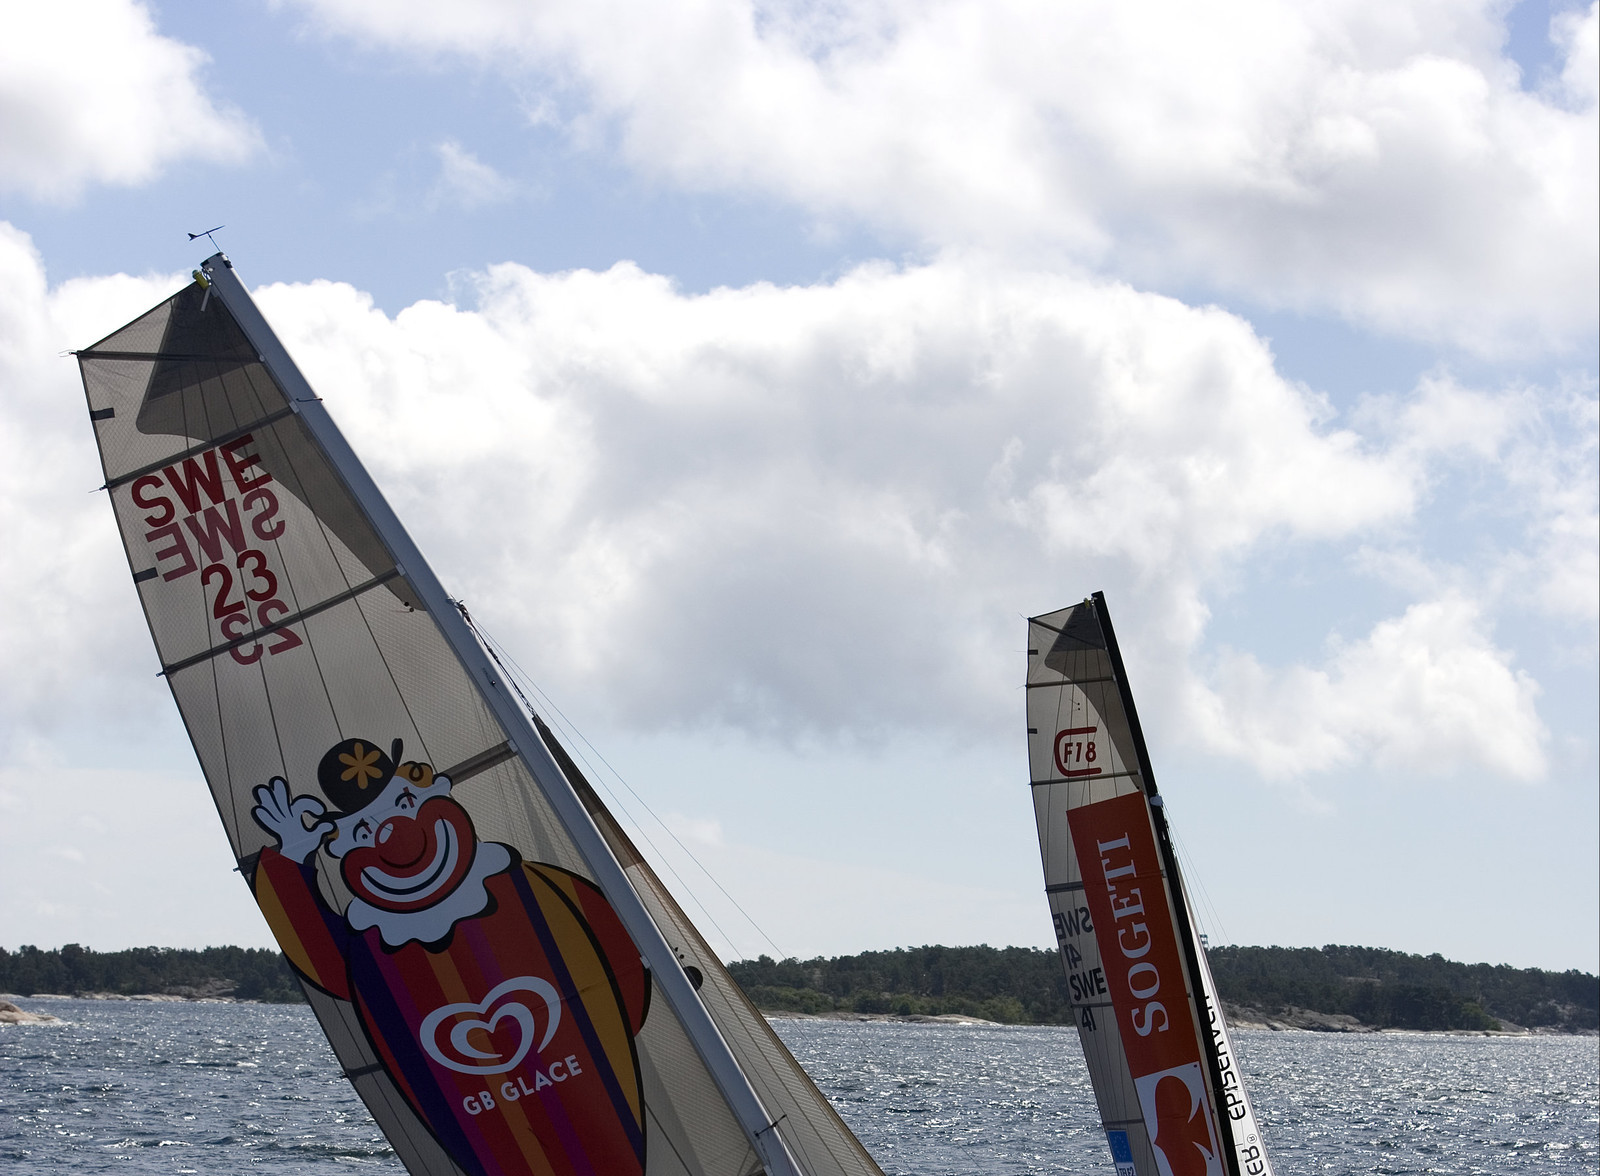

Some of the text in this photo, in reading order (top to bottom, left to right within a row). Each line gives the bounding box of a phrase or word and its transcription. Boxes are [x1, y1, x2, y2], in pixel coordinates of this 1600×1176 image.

[131, 433, 273, 527] SWE
[200, 549, 278, 619] 23
[1063, 741, 1097, 763] F18
[1097, 832, 1169, 1037] SOGETI
[1069, 967, 1107, 1001] SWE
[463, 1054, 583, 1115] GB GLACE
